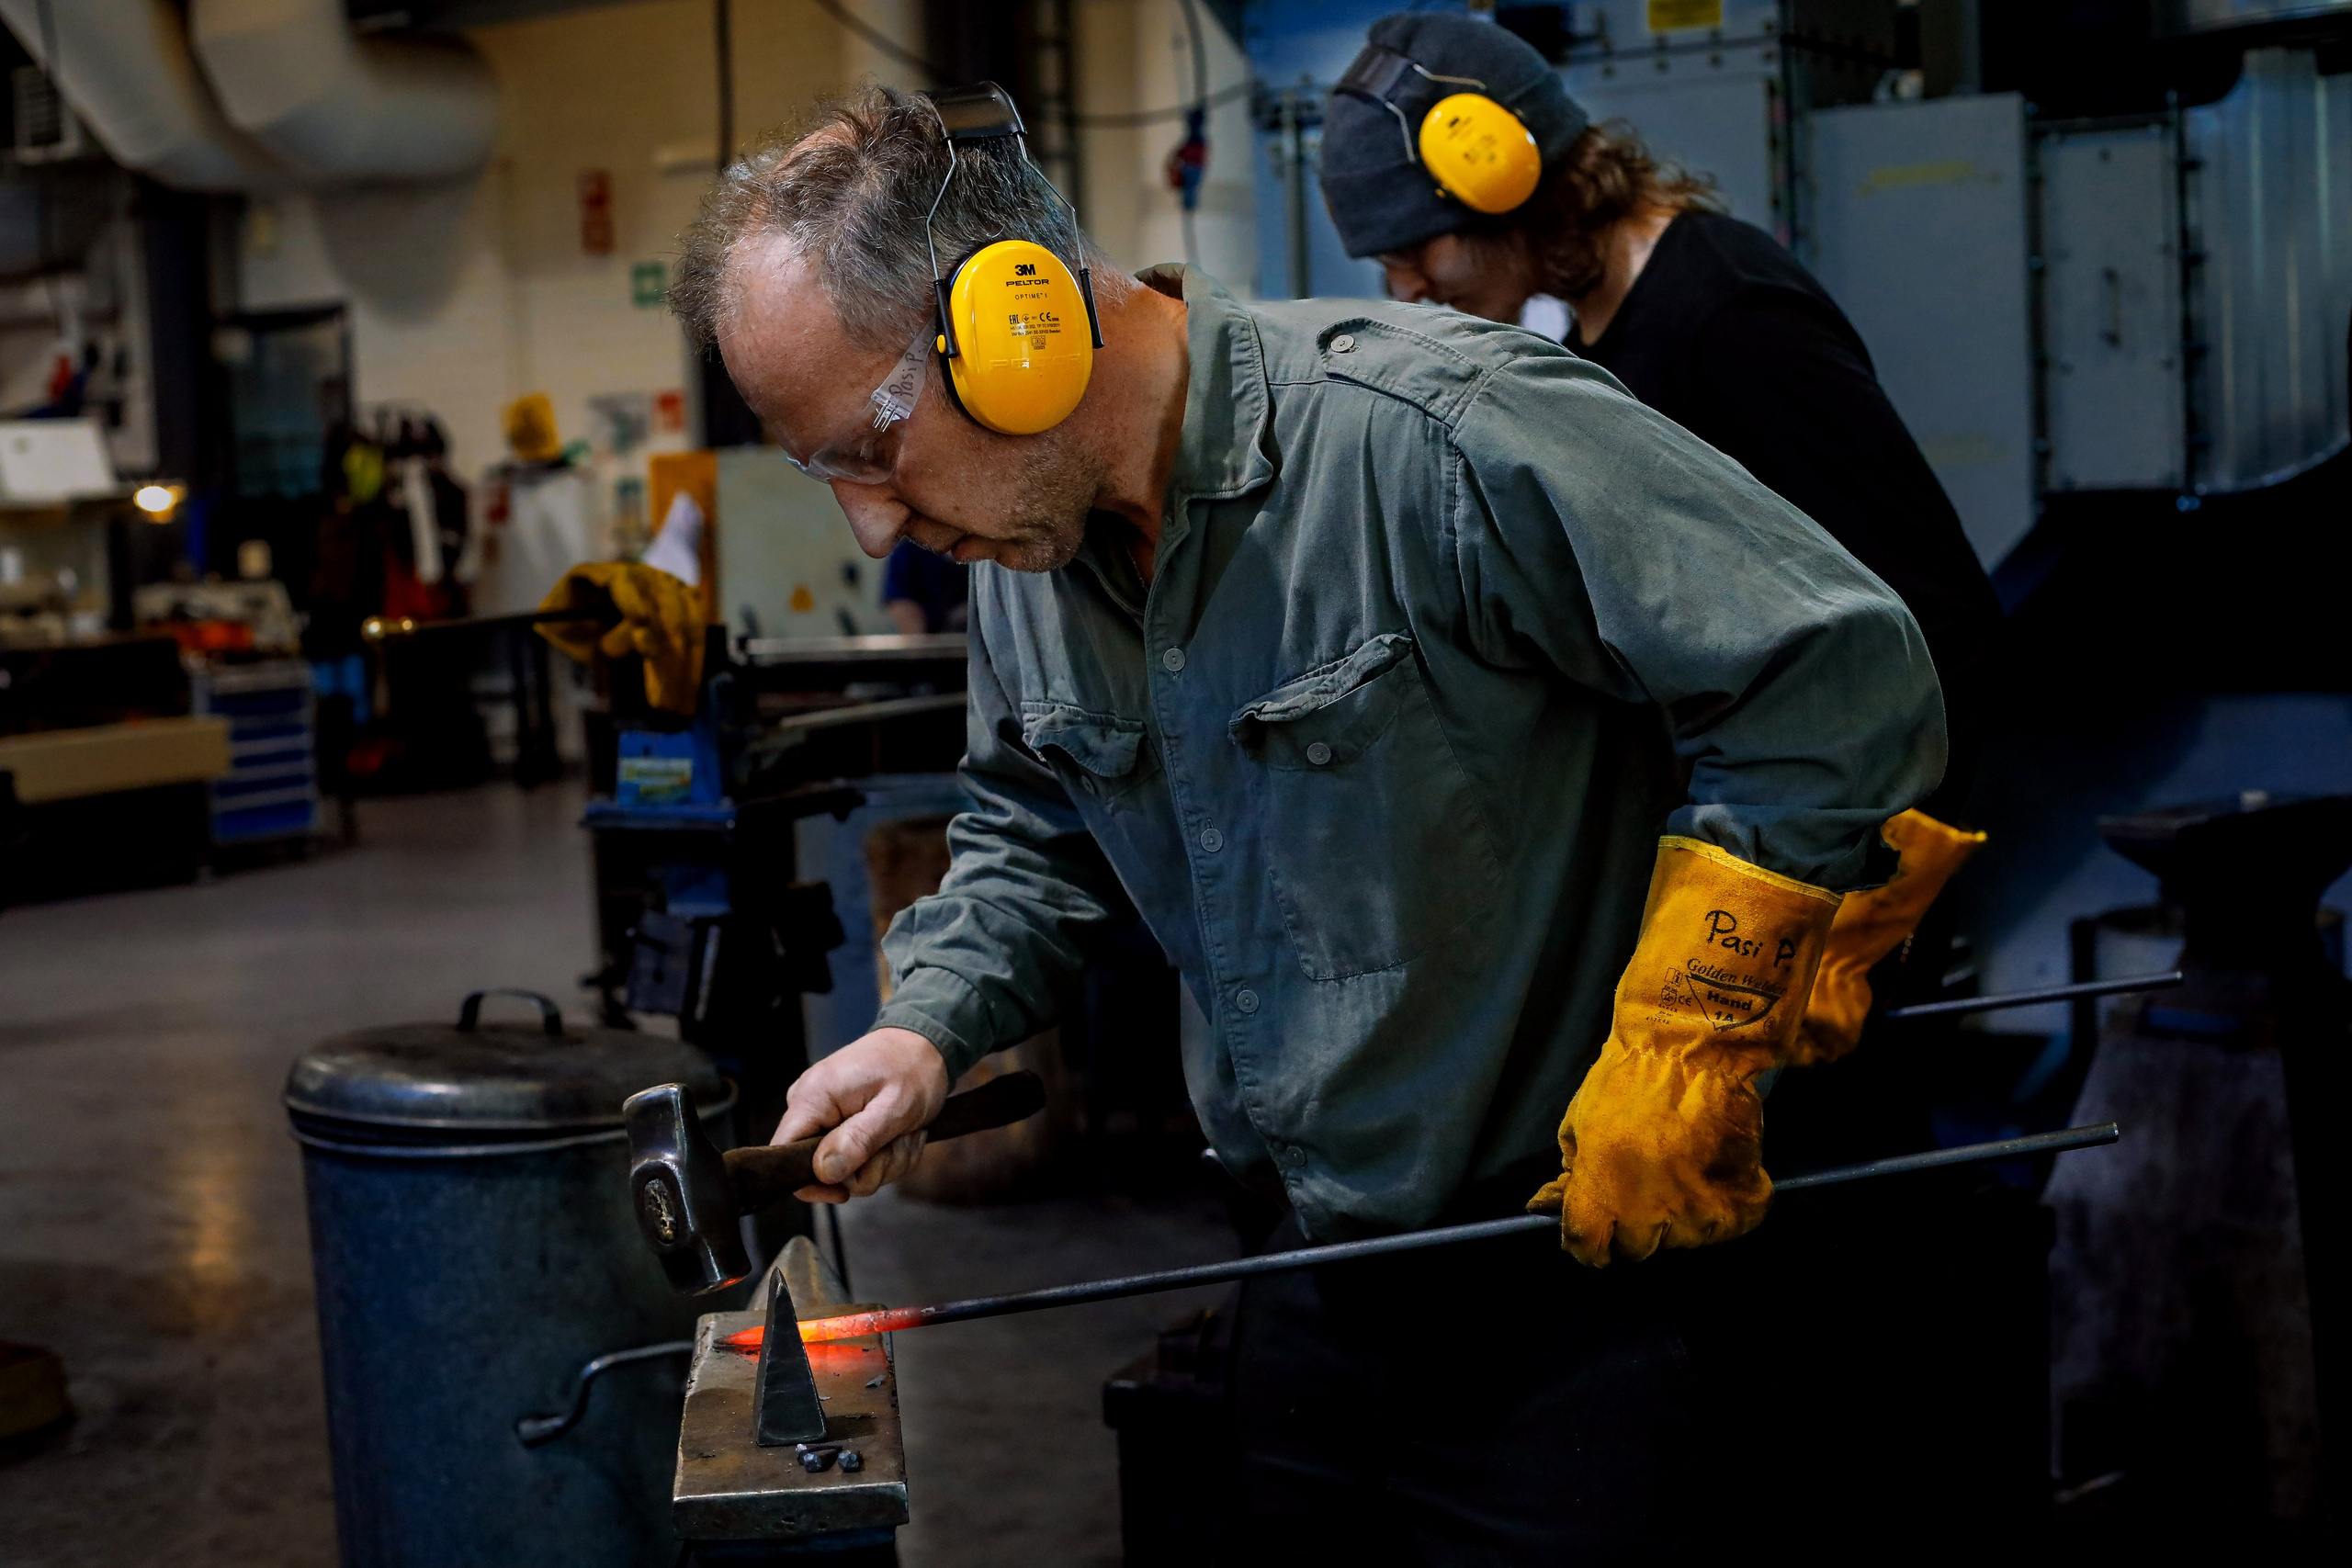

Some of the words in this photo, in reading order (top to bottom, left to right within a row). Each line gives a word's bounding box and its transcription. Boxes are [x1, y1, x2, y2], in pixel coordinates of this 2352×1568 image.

[1014, 264, 1036, 276] 3M
[1005, 278, 1050, 288] PELTOR
[888, 367, 917, 398] Pasi
[1704, 909, 1764, 958] Pasi
[1687, 957, 1737, 983] Golden
[1707, 990, 1753, 1010] Hand
[1714, 1010, 1734, 1021] 1A
